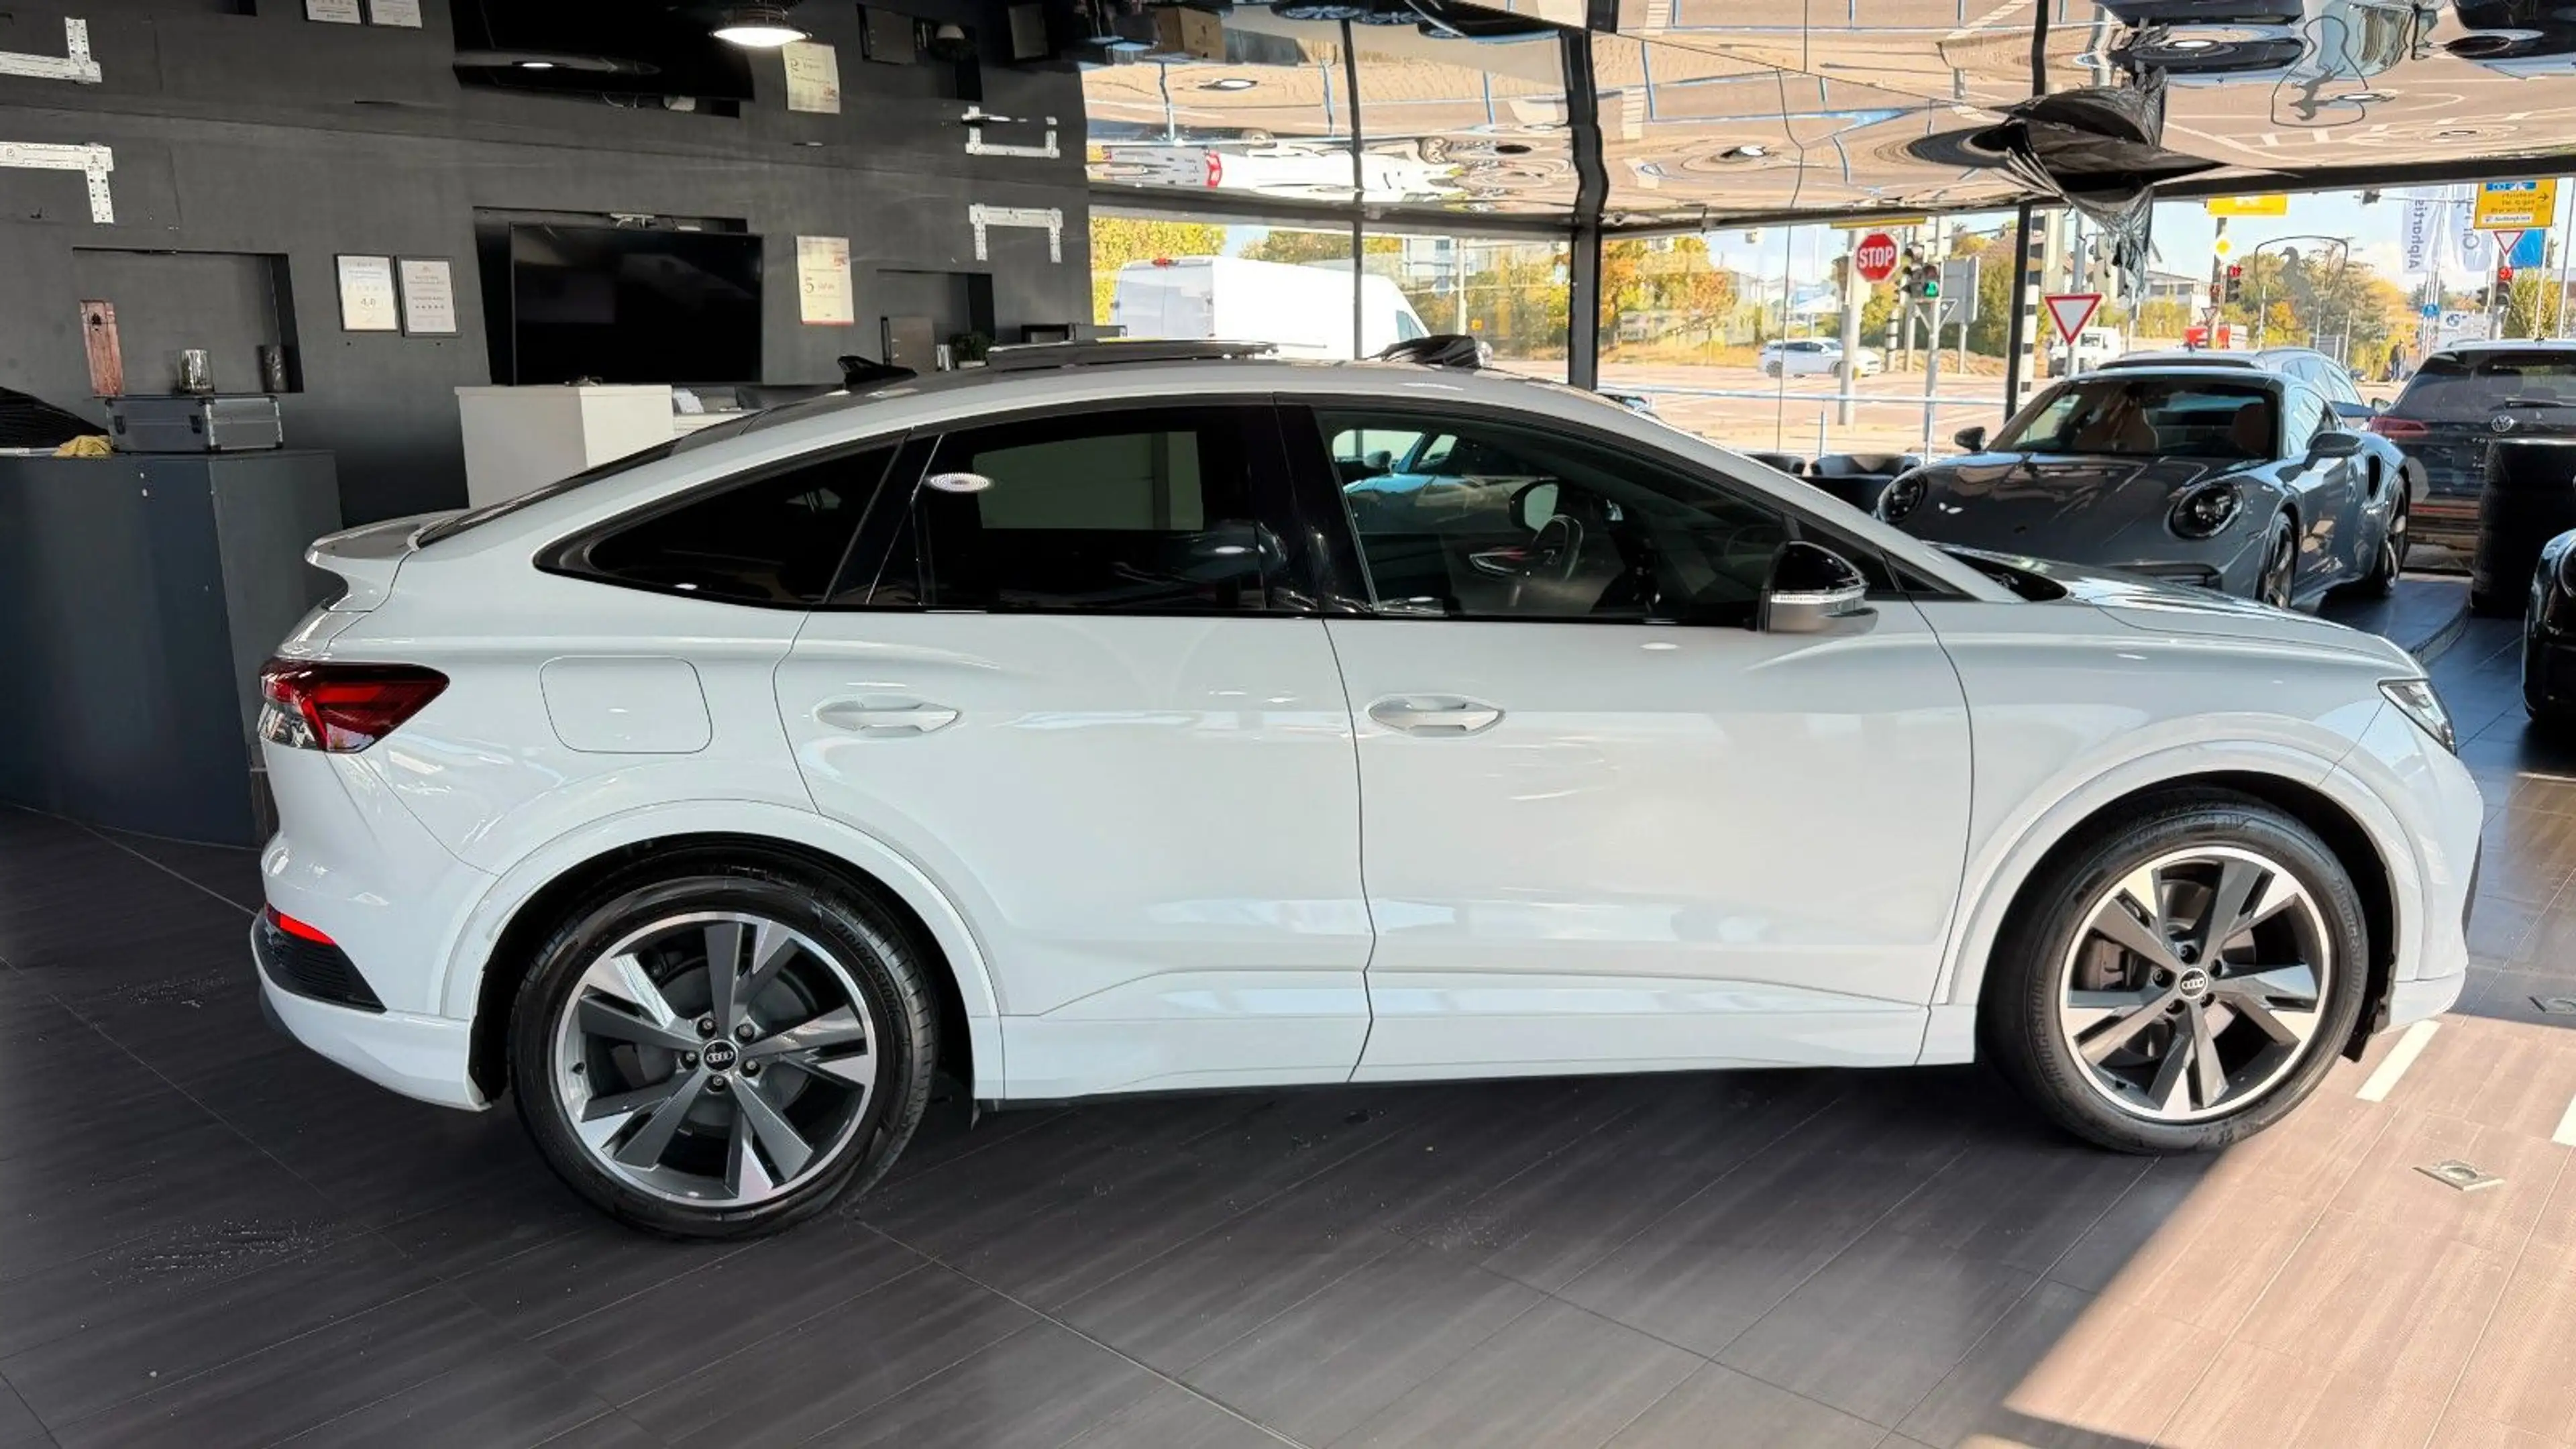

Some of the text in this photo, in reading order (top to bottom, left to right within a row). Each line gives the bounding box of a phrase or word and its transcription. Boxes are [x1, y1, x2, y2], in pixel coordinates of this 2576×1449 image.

[1860, 246, 1894, 268] STOP
[831, 920, 901, 1018] BRIDGESTONE
[2033, 971, 2069, 1087] BRIDGESTONE
